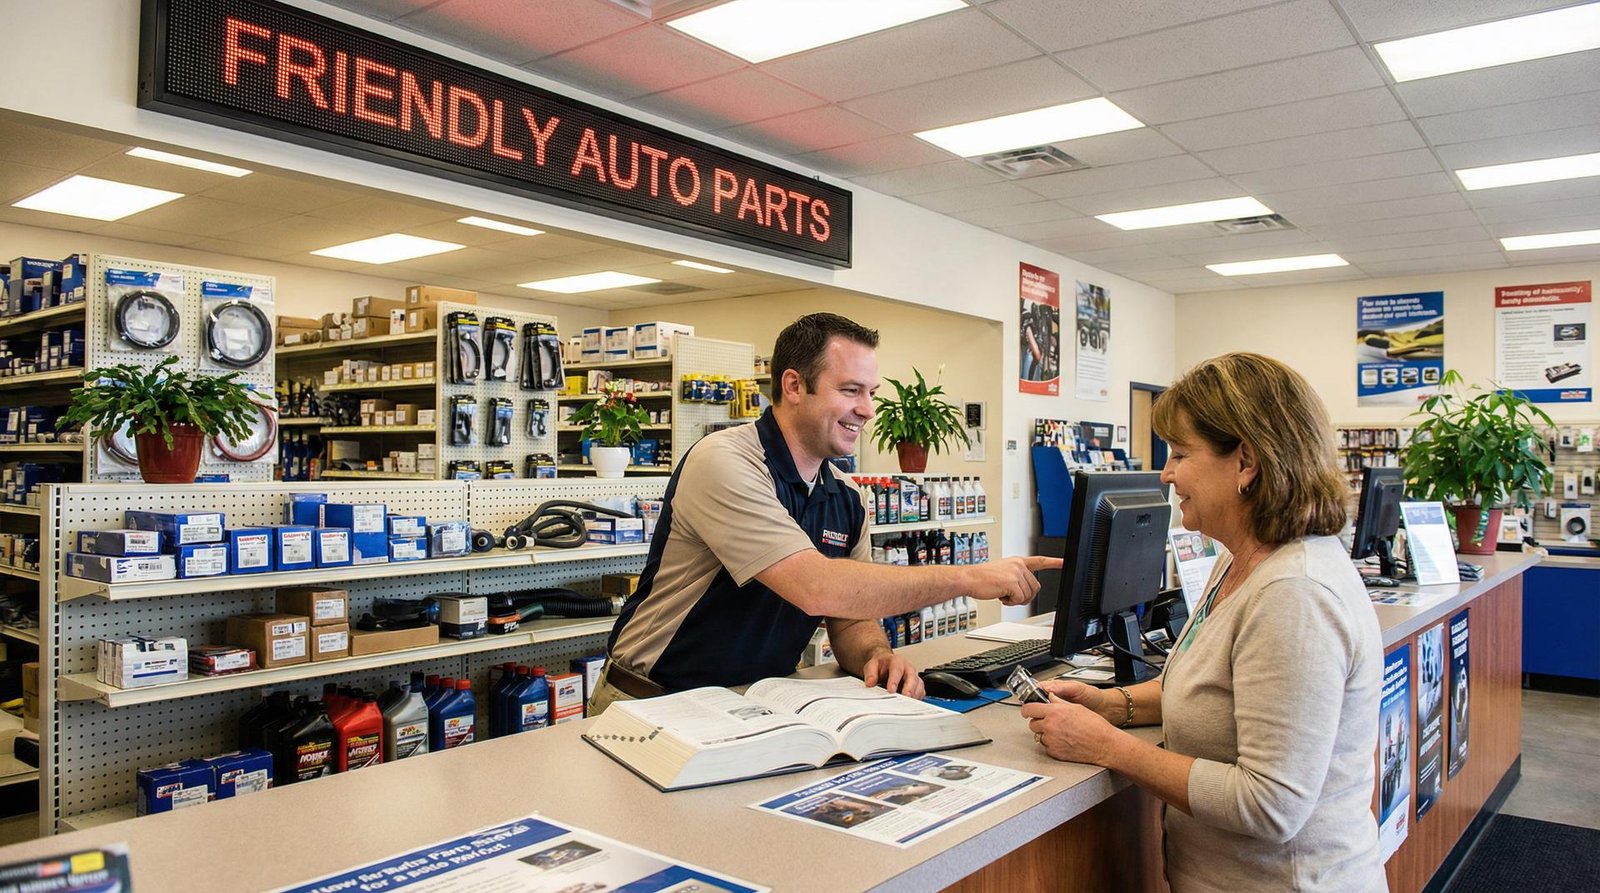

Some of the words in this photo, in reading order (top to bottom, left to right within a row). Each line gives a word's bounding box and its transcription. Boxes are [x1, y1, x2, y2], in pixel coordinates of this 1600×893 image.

[224, 16, 561, 166] FRIENDLY
[570, 128, 701, 206] AUTO
[713, 168, 831, 242] PARTS
